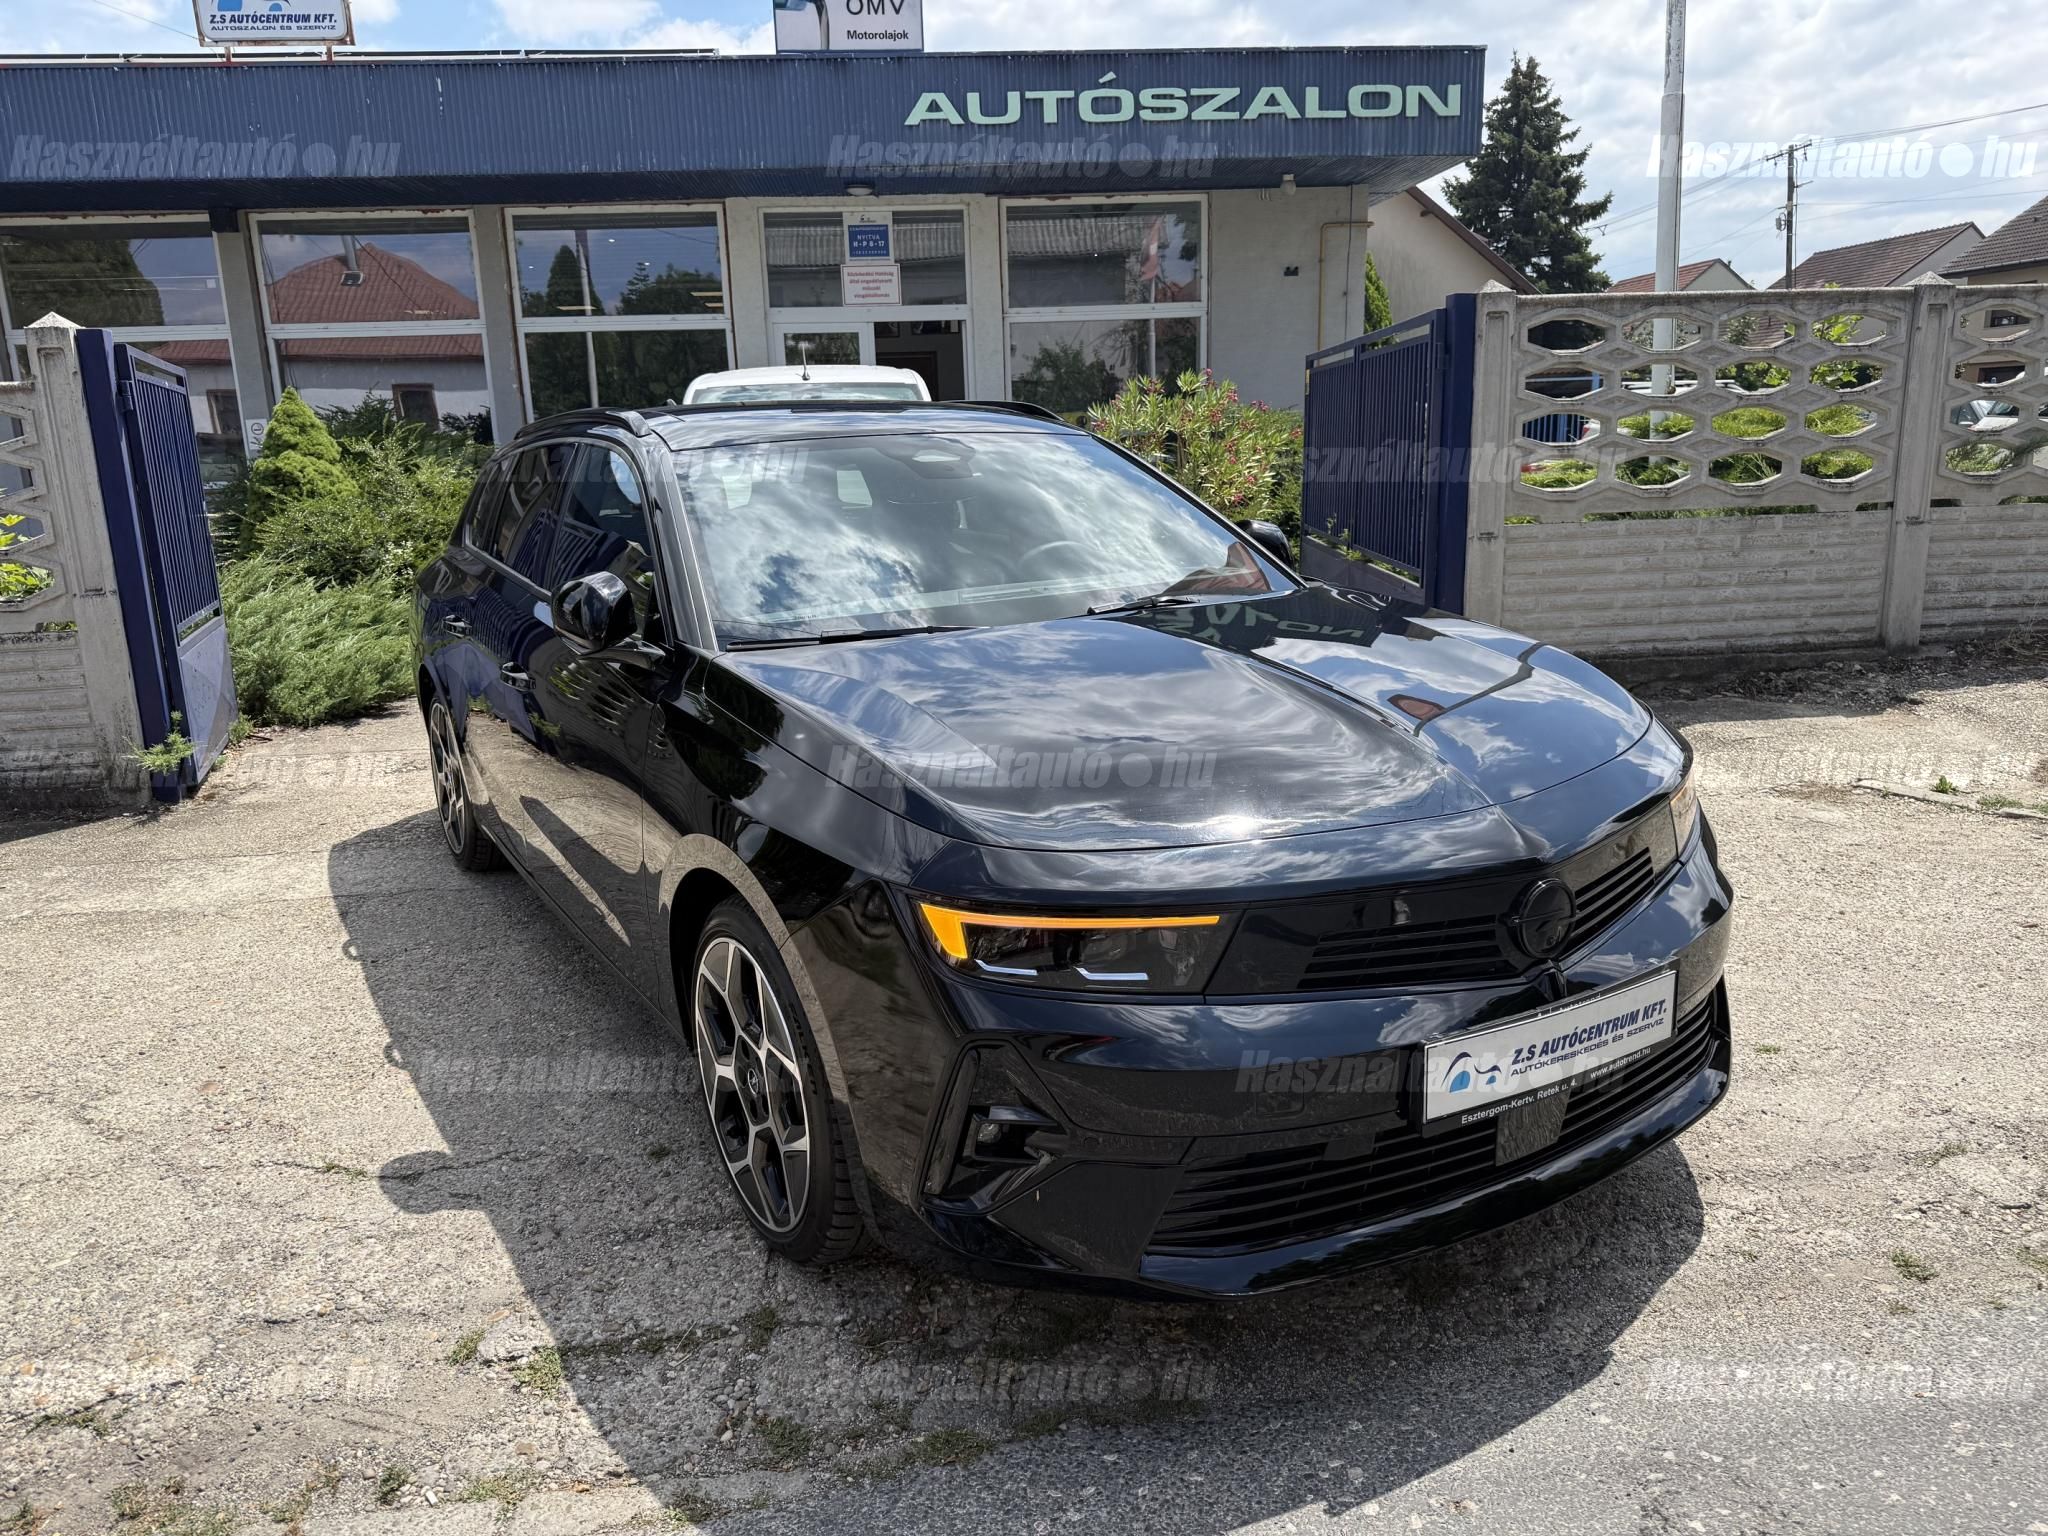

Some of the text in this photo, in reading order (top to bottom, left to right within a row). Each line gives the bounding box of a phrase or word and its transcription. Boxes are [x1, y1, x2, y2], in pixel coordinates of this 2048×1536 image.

[209, 11, 337, 24] Z.S AUTÓCENTRUM KFT.
[846, 0, 905, 15] OMV
[847, 30, 909, 42] Motorolajok
[903, 71, 1462, 125] AUTÓSZALON
[1511, 998, 1667, 1066] Z.S AUTÓCENTRUM KFT.
[1511, 1018, 1664, 1077] AUTÓKERESKEDÉS ÉS SZERVIZ
[1461, 1094, 1535, 1125] Esztergom-Kertv.
[1537, 1084, 1560, 1100] Retek
[1590, 1047, 1651, 1079] www.autotrend.hu
